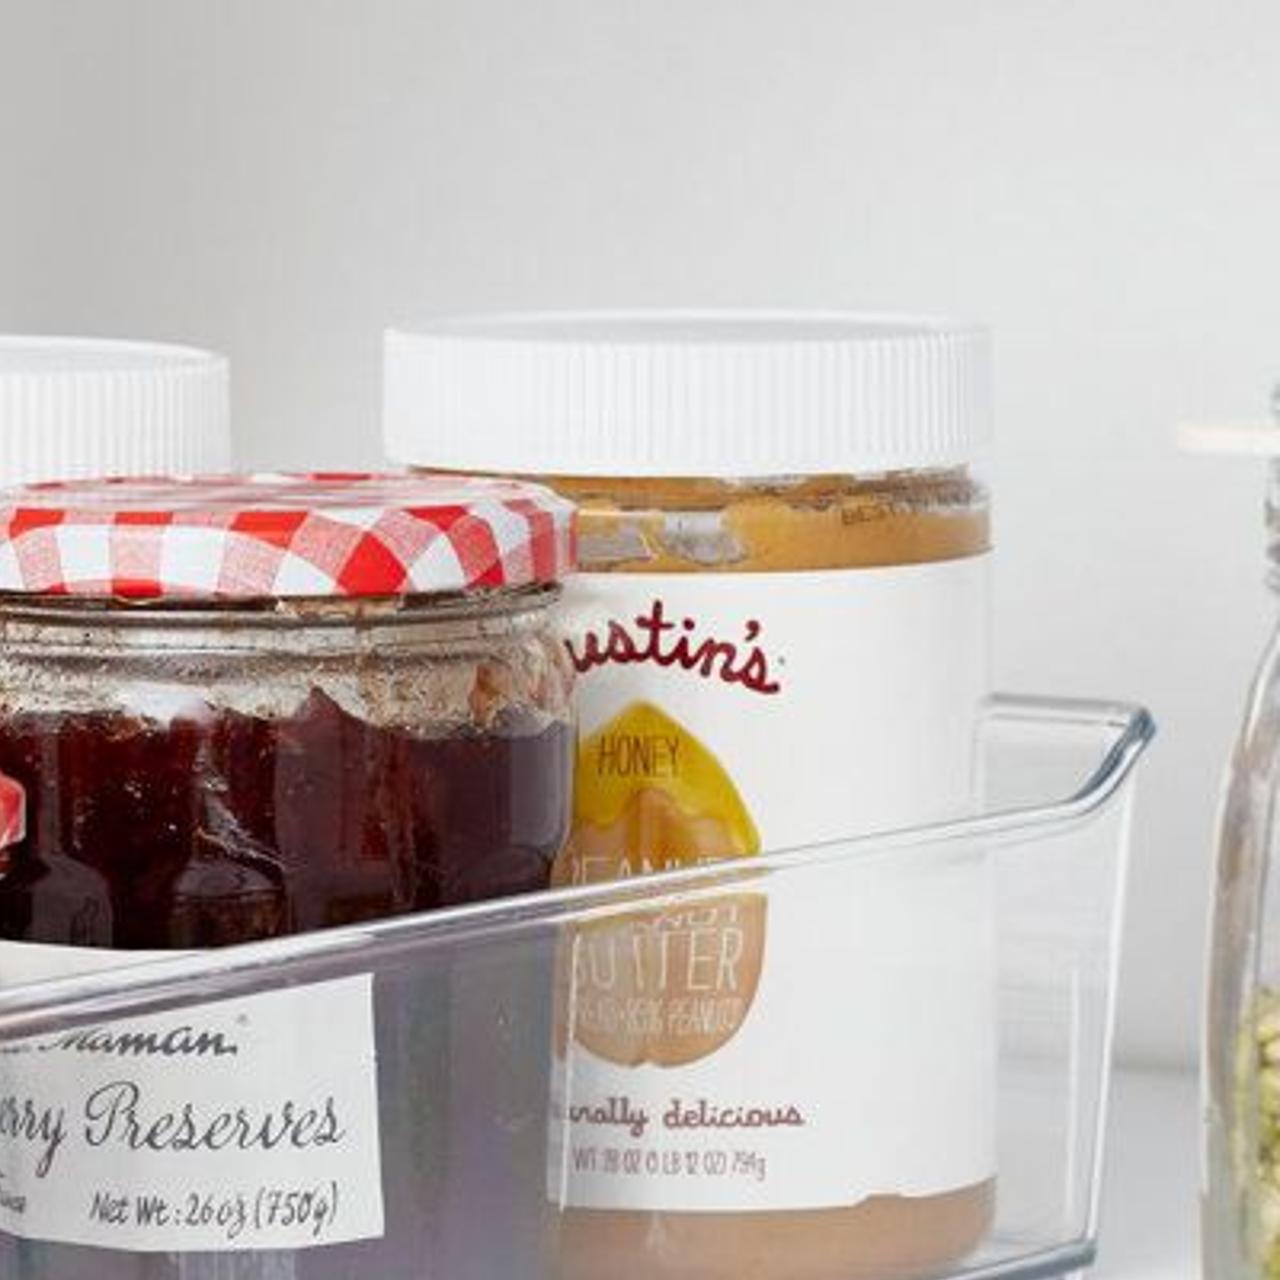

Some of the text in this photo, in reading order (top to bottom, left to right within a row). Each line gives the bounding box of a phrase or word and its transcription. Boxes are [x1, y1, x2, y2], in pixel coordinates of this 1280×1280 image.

[564, 600, 781, 696] ustin's
[597, 734, 682, 778] HONEY
[84, 1080, 344, 1151] Preserves
[662, 1098, 806, 1129] delicious
[662, 1150, 682, 1176] LB
[88, 1190, 130, 1224] Net
[254, 1182, 339, 1237] (750g)
